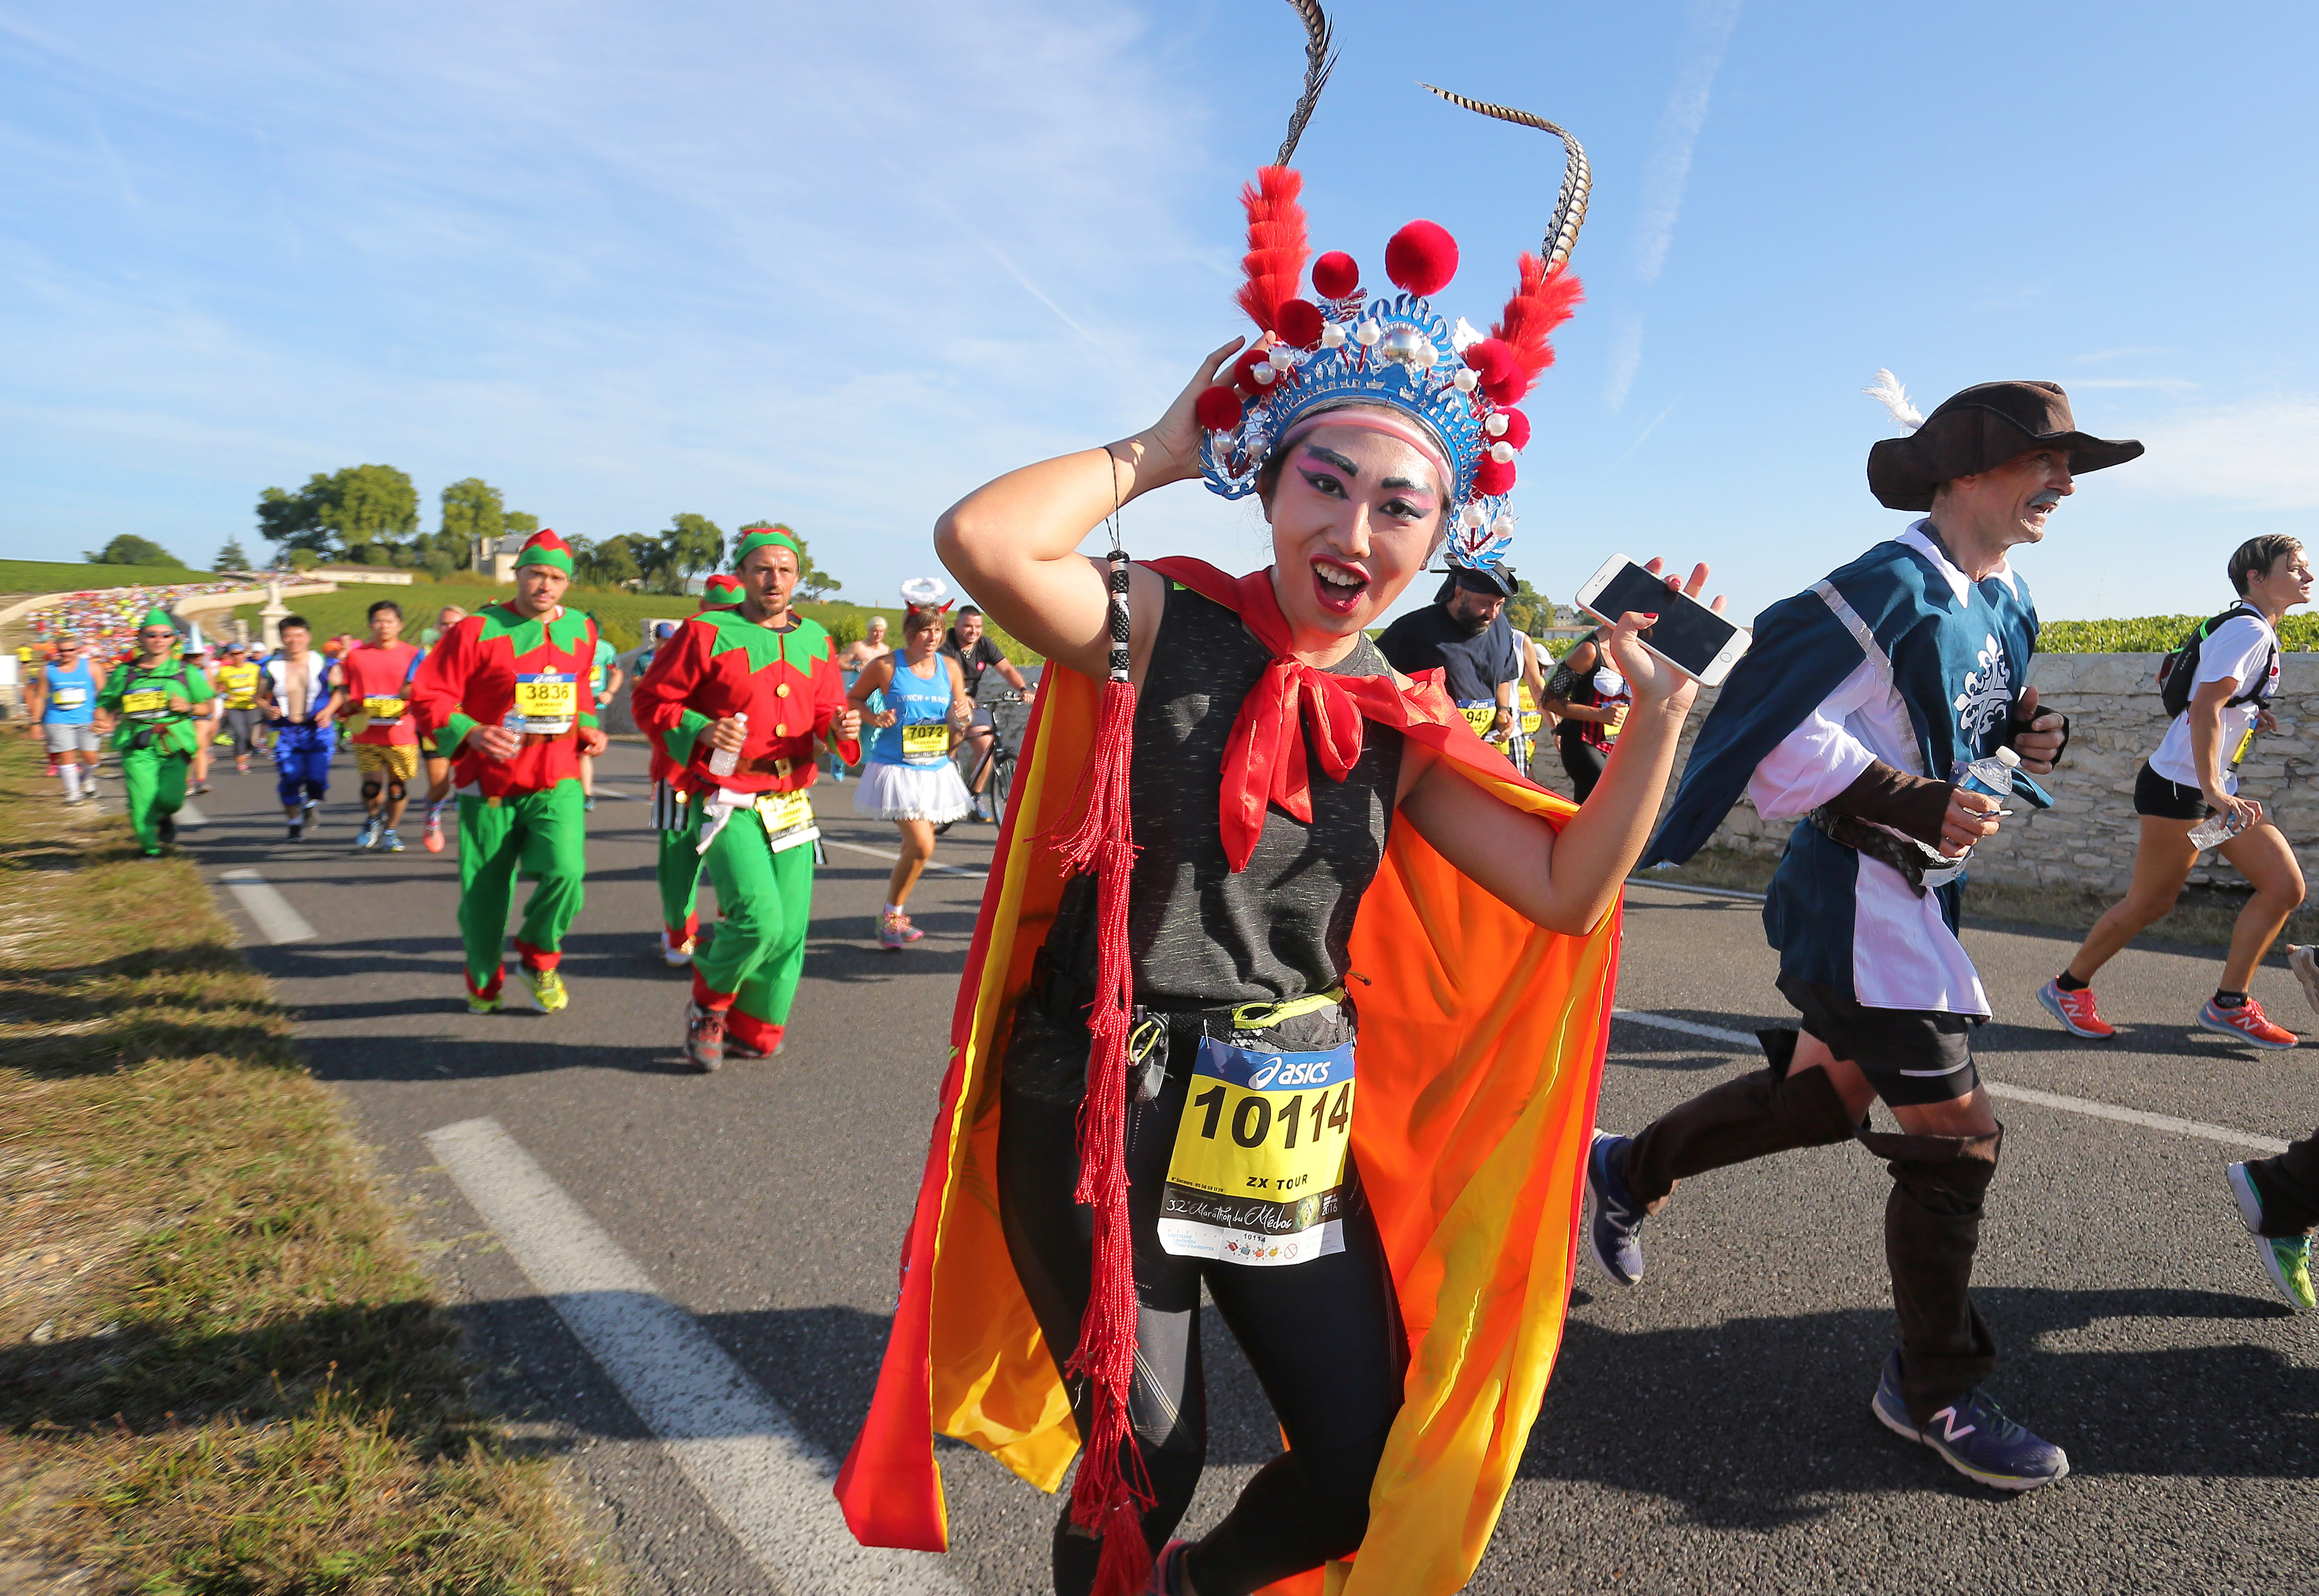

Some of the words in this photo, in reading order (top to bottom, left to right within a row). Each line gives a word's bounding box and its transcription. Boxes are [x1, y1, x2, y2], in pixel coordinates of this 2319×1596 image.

[525, 685, 569, 700] 3836
[897, 694, 923, 703] LYNCH
[1466, 710, 1489, 724] 943
[909, 727, 943, 738] 7072
[1278, 1061, 1332, 1085] asics
[1194, 1083, 1350, 1149] 10114
[1246, 1176, 1269, 1188] ZX
[1276, 1174, 1308, 1190] TOUR
[1188, 1202, 1232, 1228] Marathon
[1232, 1207, 1243, 1223] du
[1321, 1202, 1338, 1216] 2016
[1243, 1233, 1266, 1243] 10114
[1172, 1242, 1215, 1251] ITOU-CHARENTES
[1929, 1405, 1976, 1443] N
